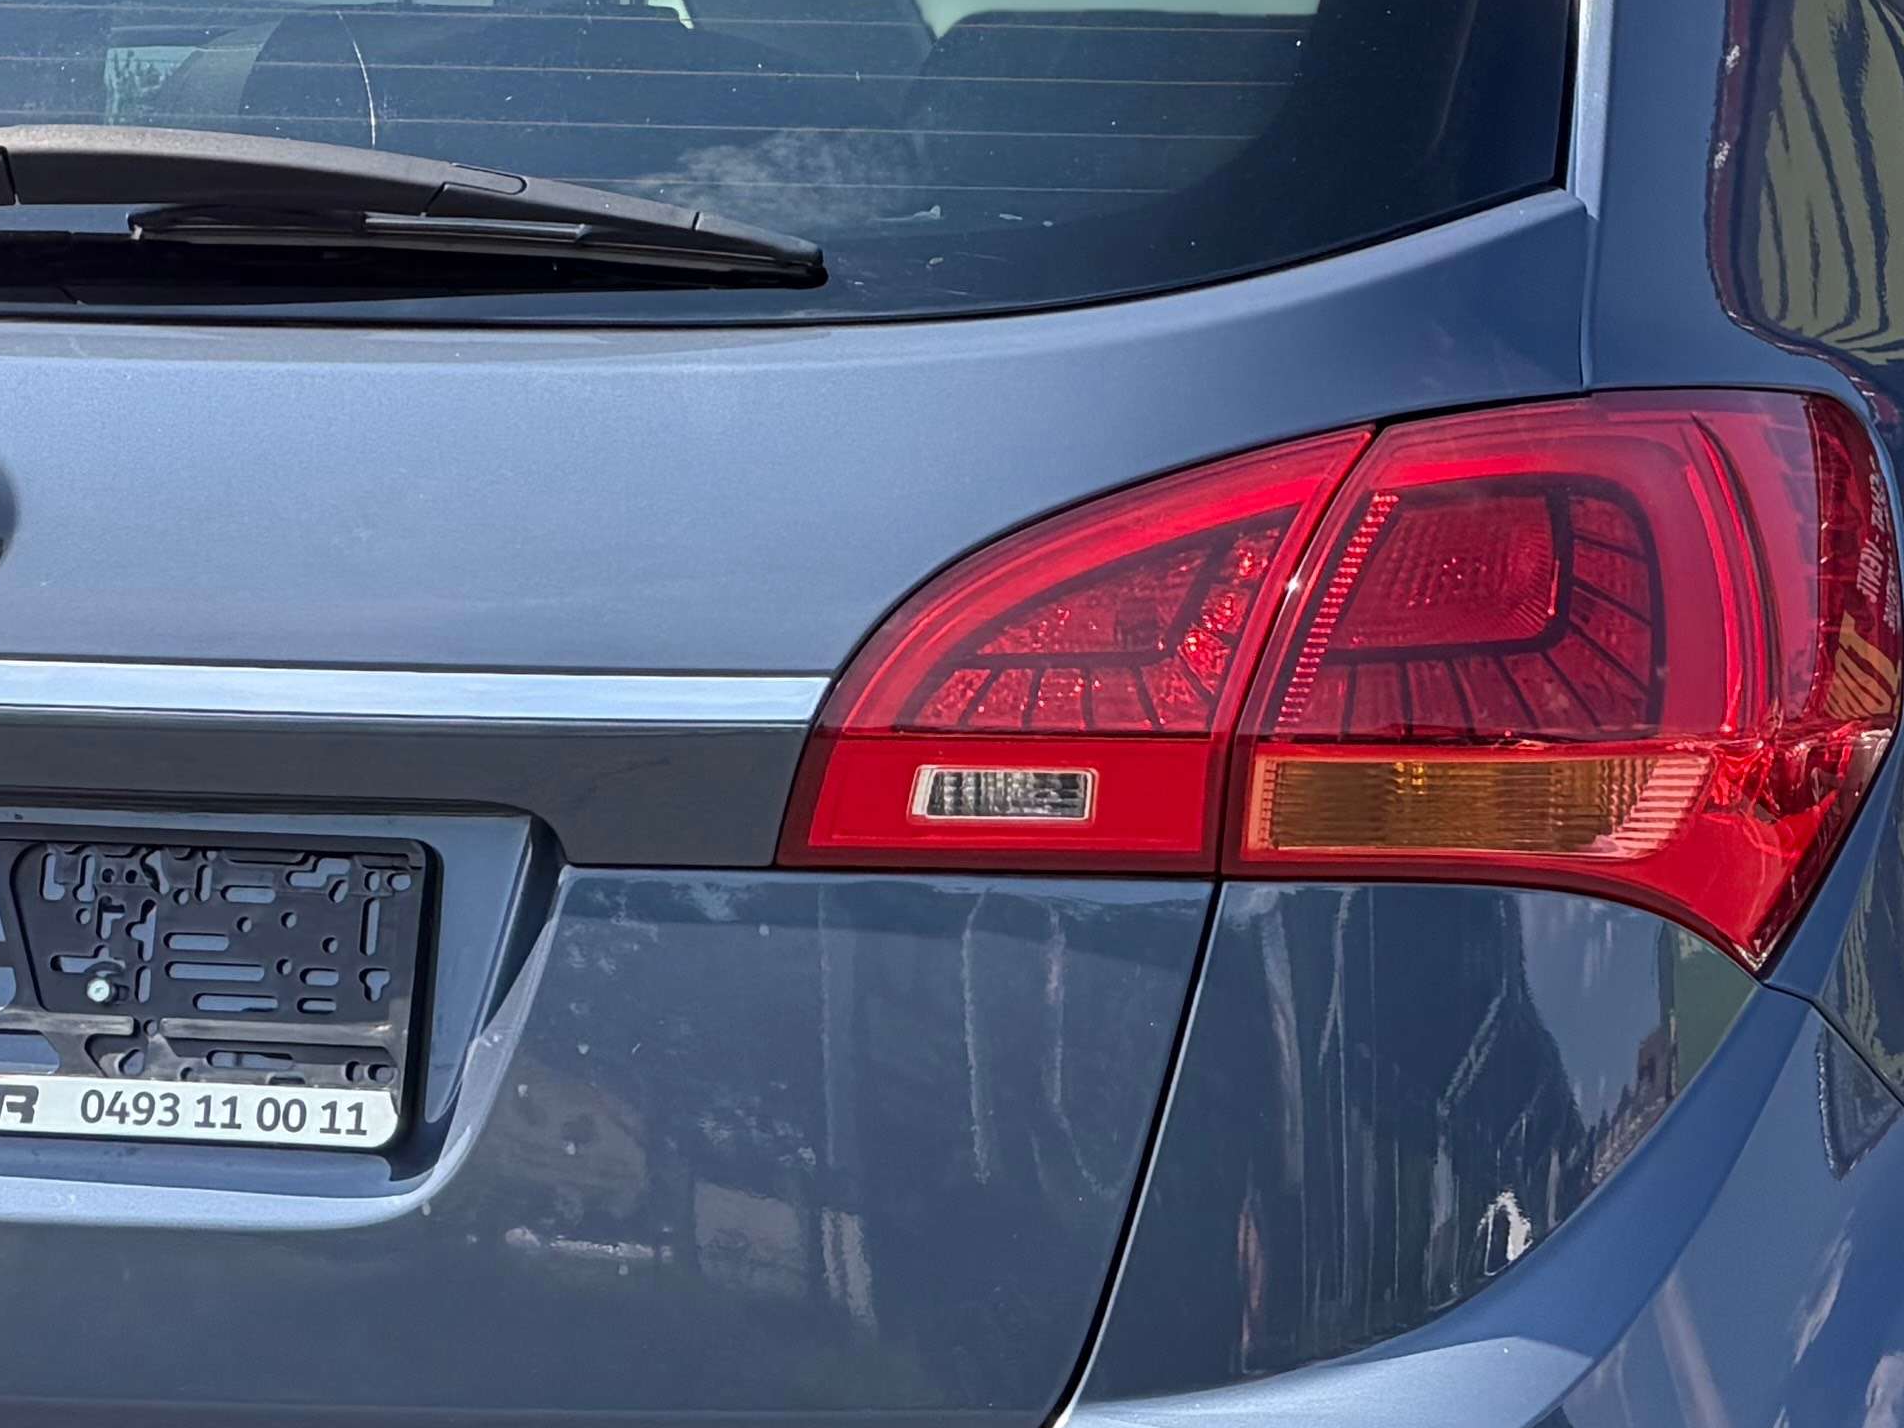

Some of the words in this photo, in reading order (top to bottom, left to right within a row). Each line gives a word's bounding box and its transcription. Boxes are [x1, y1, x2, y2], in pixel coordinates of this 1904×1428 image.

[80, 1089, 180, 1127] 0493
[193, 1093, 243, 1130] 11
[256, 1096, 307, 1133] 00
[318, 1099, 369, 1136] 11
